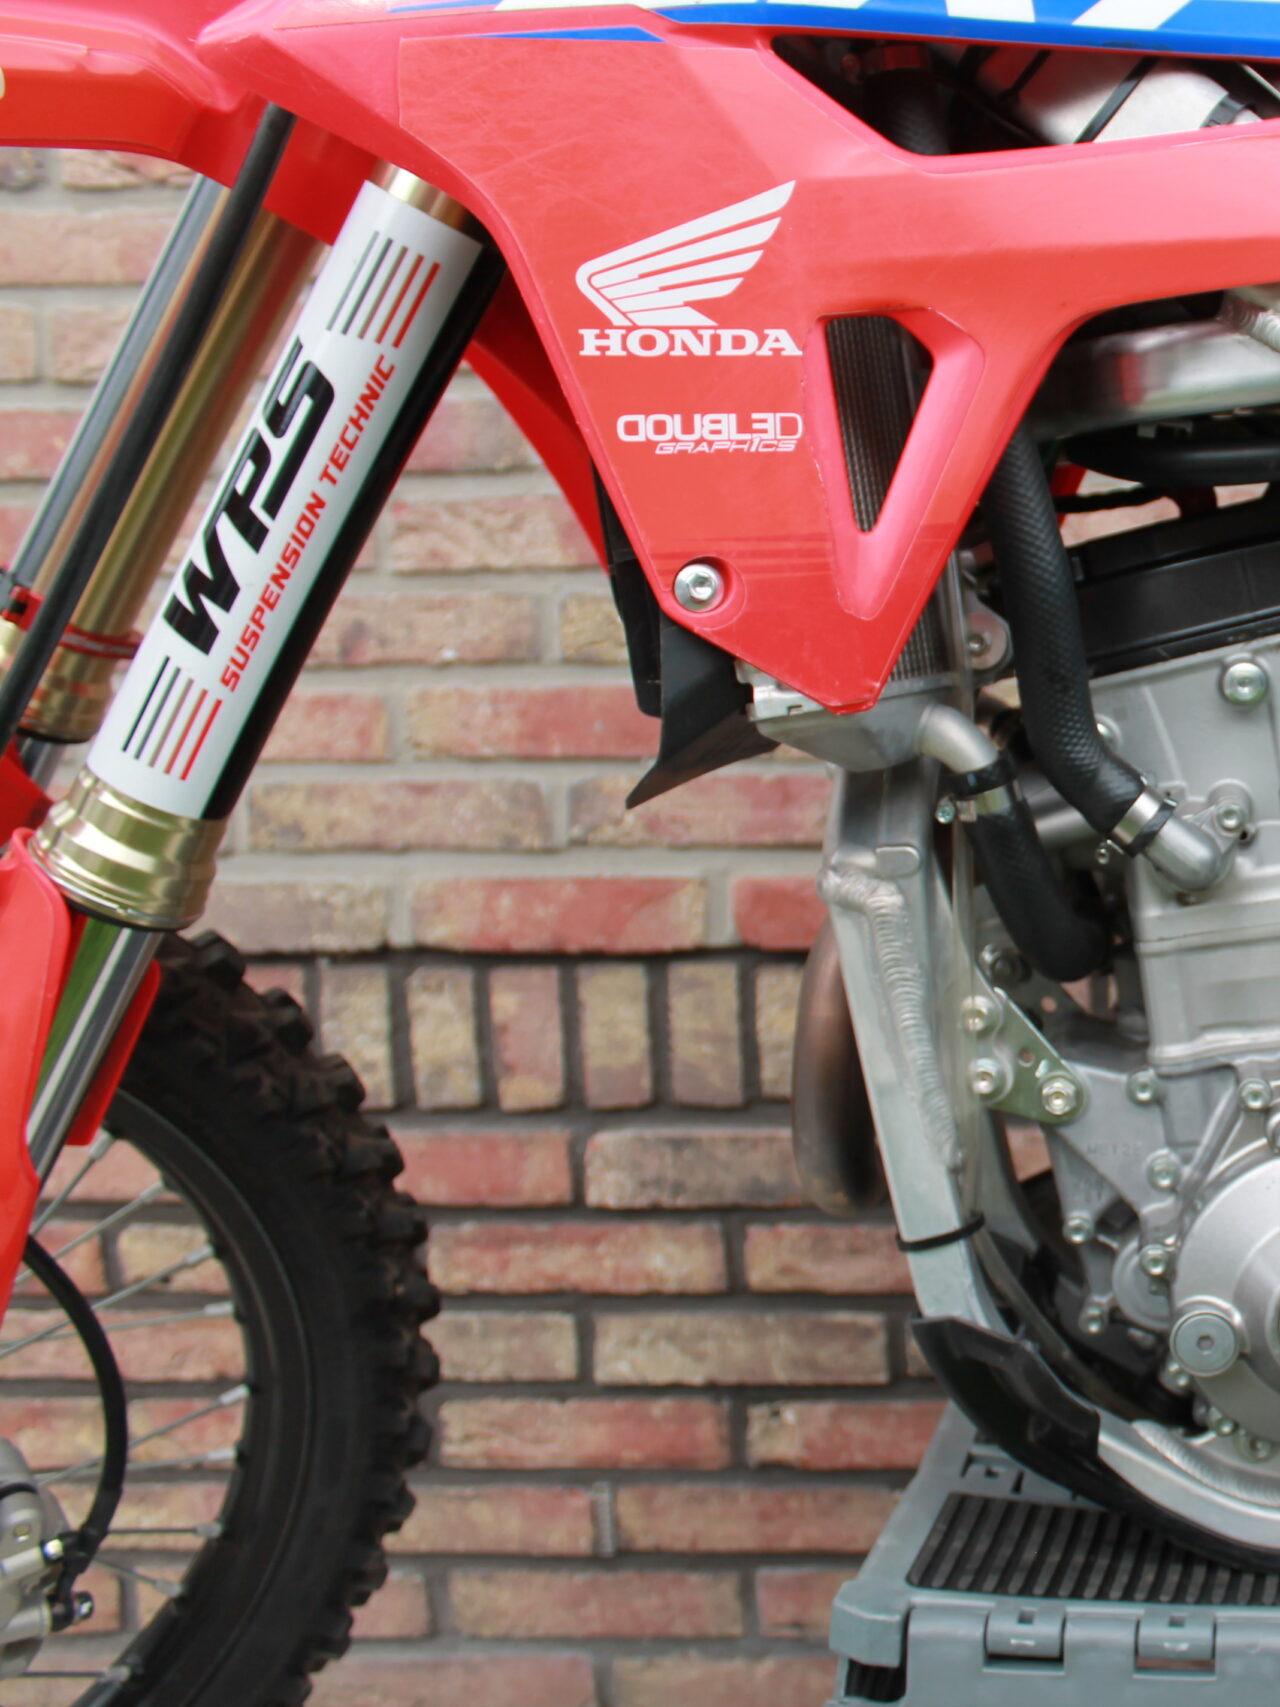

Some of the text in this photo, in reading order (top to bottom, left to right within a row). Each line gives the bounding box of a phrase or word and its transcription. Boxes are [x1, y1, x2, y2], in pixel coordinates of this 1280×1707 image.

[163, 336, 335, 656] WPS
[578, 328, 803, 357] HONDA
[221, 354, 396, 692] SUSPENSION TECHNIC
